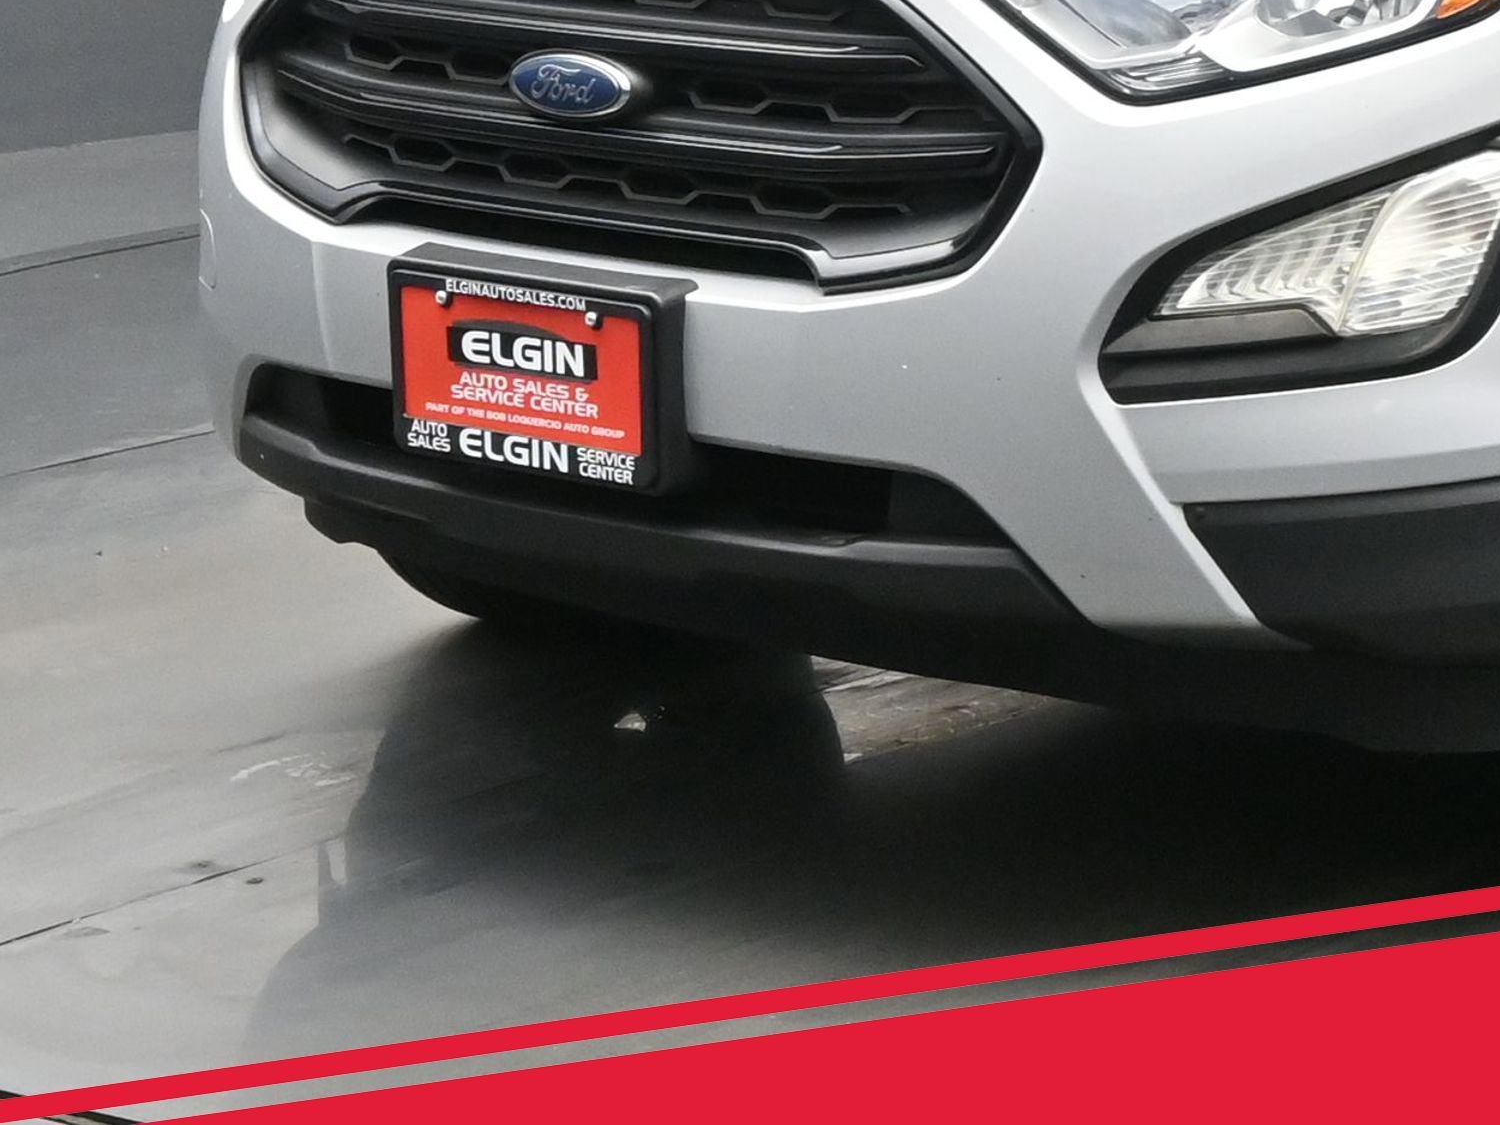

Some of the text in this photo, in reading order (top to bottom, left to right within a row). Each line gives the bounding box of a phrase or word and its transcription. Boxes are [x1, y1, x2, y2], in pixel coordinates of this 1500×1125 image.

[530, 63, 597, 104] Ford
[445, 278, 587, 311] ELGINAUTOSALES.COM
[460, 329, 586, 377] ELGIN
[450, 385, 599, 419] SERVICE CENTER
[459, 371, 590, 402] AUTO SALES &
[410, 419, 449, 438] AUTO
[425, 402, 450, 414] PART
[451, 404, 465, 416] OF
[466, 407, 485, 419] THE
[563, 422, 590, 435] AUTO
[591, 426, 626, 439] GROUP
[407, 433, 452, 453] SALES
[459, 427, 570, 474] ELGIN
[576, 447, 637, 471] SERVICE
[579, 462, 634, 486] CENTER
